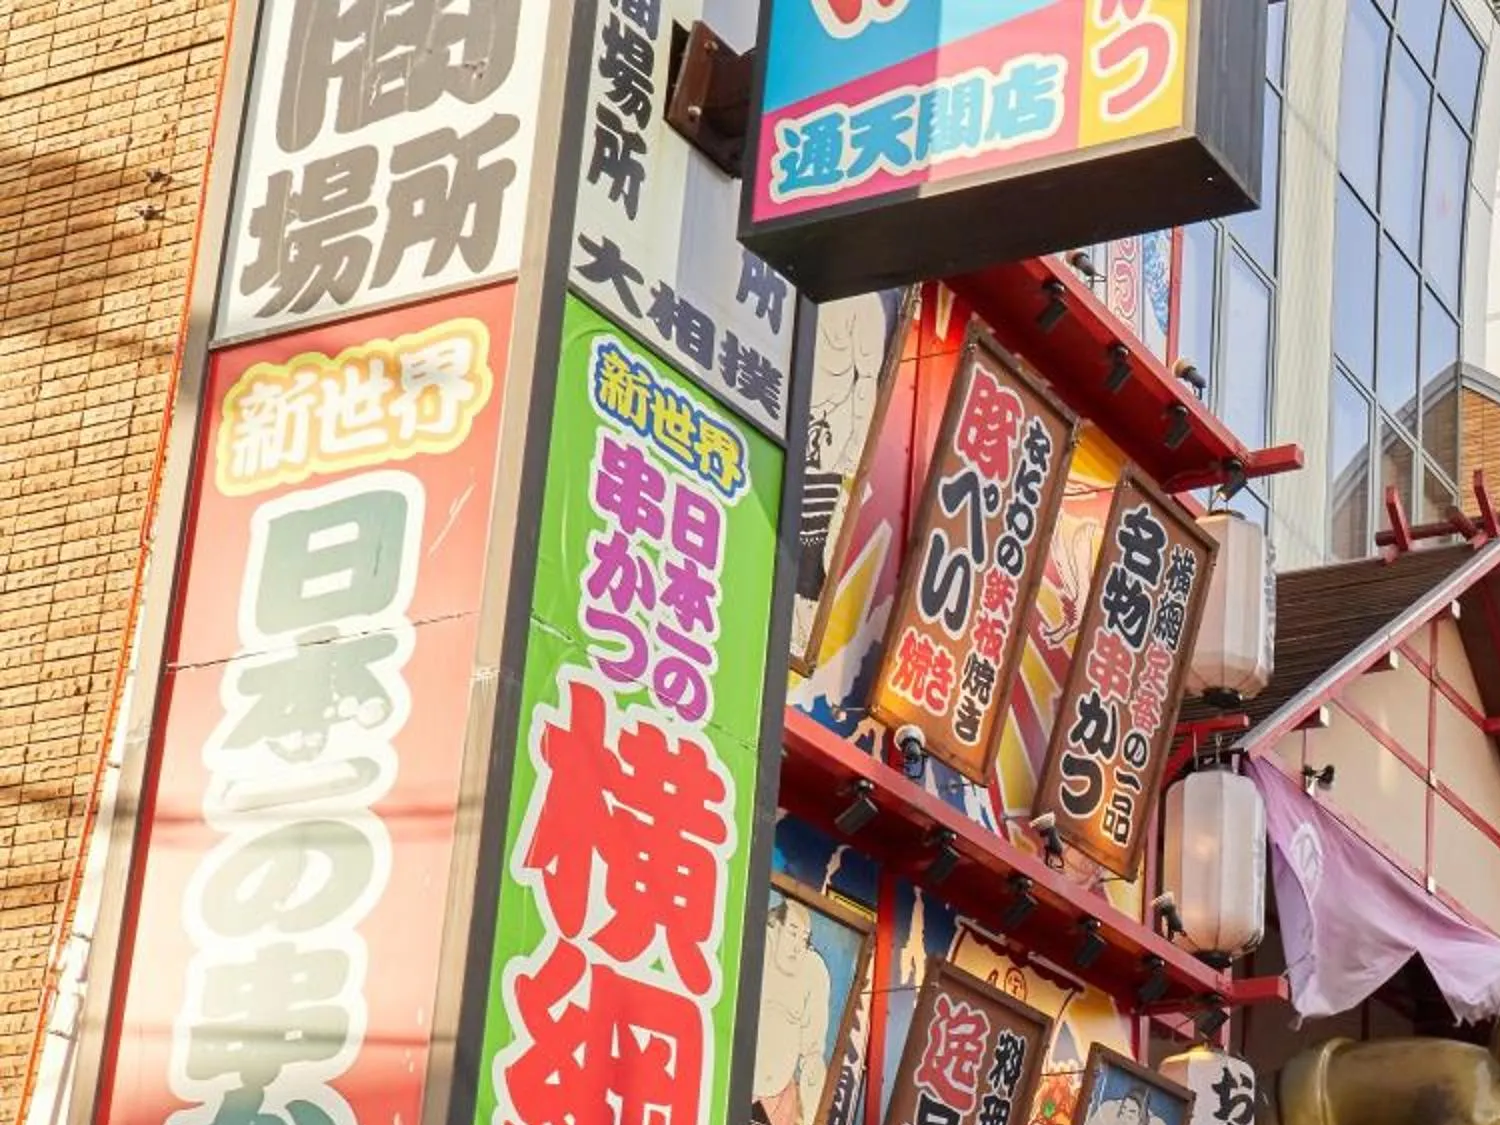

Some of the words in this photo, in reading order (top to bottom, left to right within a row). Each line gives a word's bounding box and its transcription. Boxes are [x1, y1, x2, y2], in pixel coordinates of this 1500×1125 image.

[239, 113, 521, 318] 場所
[776, 62, 1061, 195] 通天閣店
[228, 343, 481, 478] 新世界
[575, 232, 783, 420] 大相撲
[595, 346, 747, 492] 新世界
[589, 439, 666, 682] 串かつ
[656, 489, 721, 719] 日本一の
